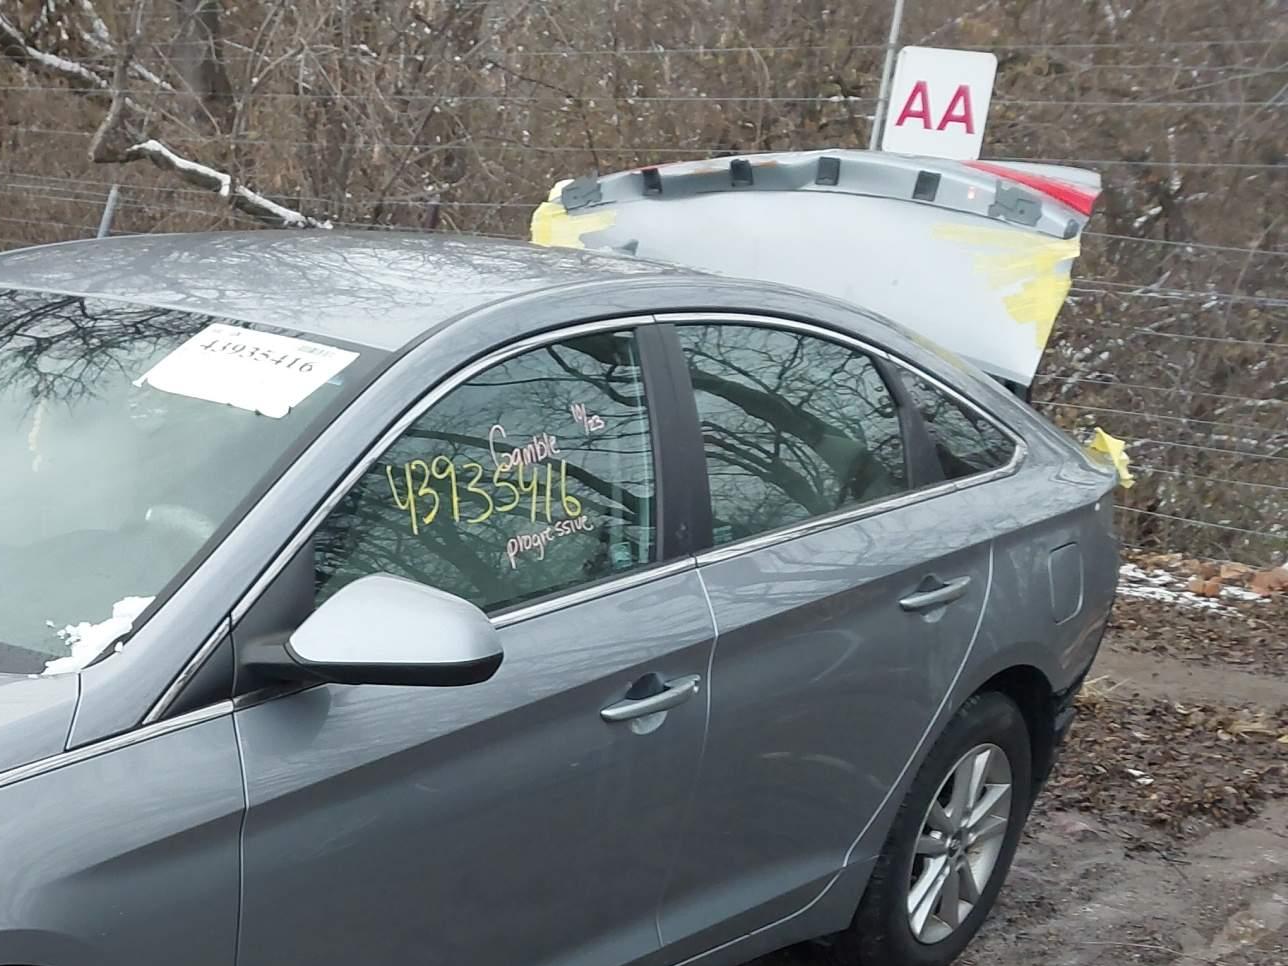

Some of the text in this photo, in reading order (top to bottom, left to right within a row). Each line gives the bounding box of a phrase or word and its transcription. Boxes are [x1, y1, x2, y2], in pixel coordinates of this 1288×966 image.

[895, 80, 975, 134] AA
[200, 339, 318, 373] 43935416
[489, 424, 560, 472] Gamble
[386, 455, 582, 535] 43935416
